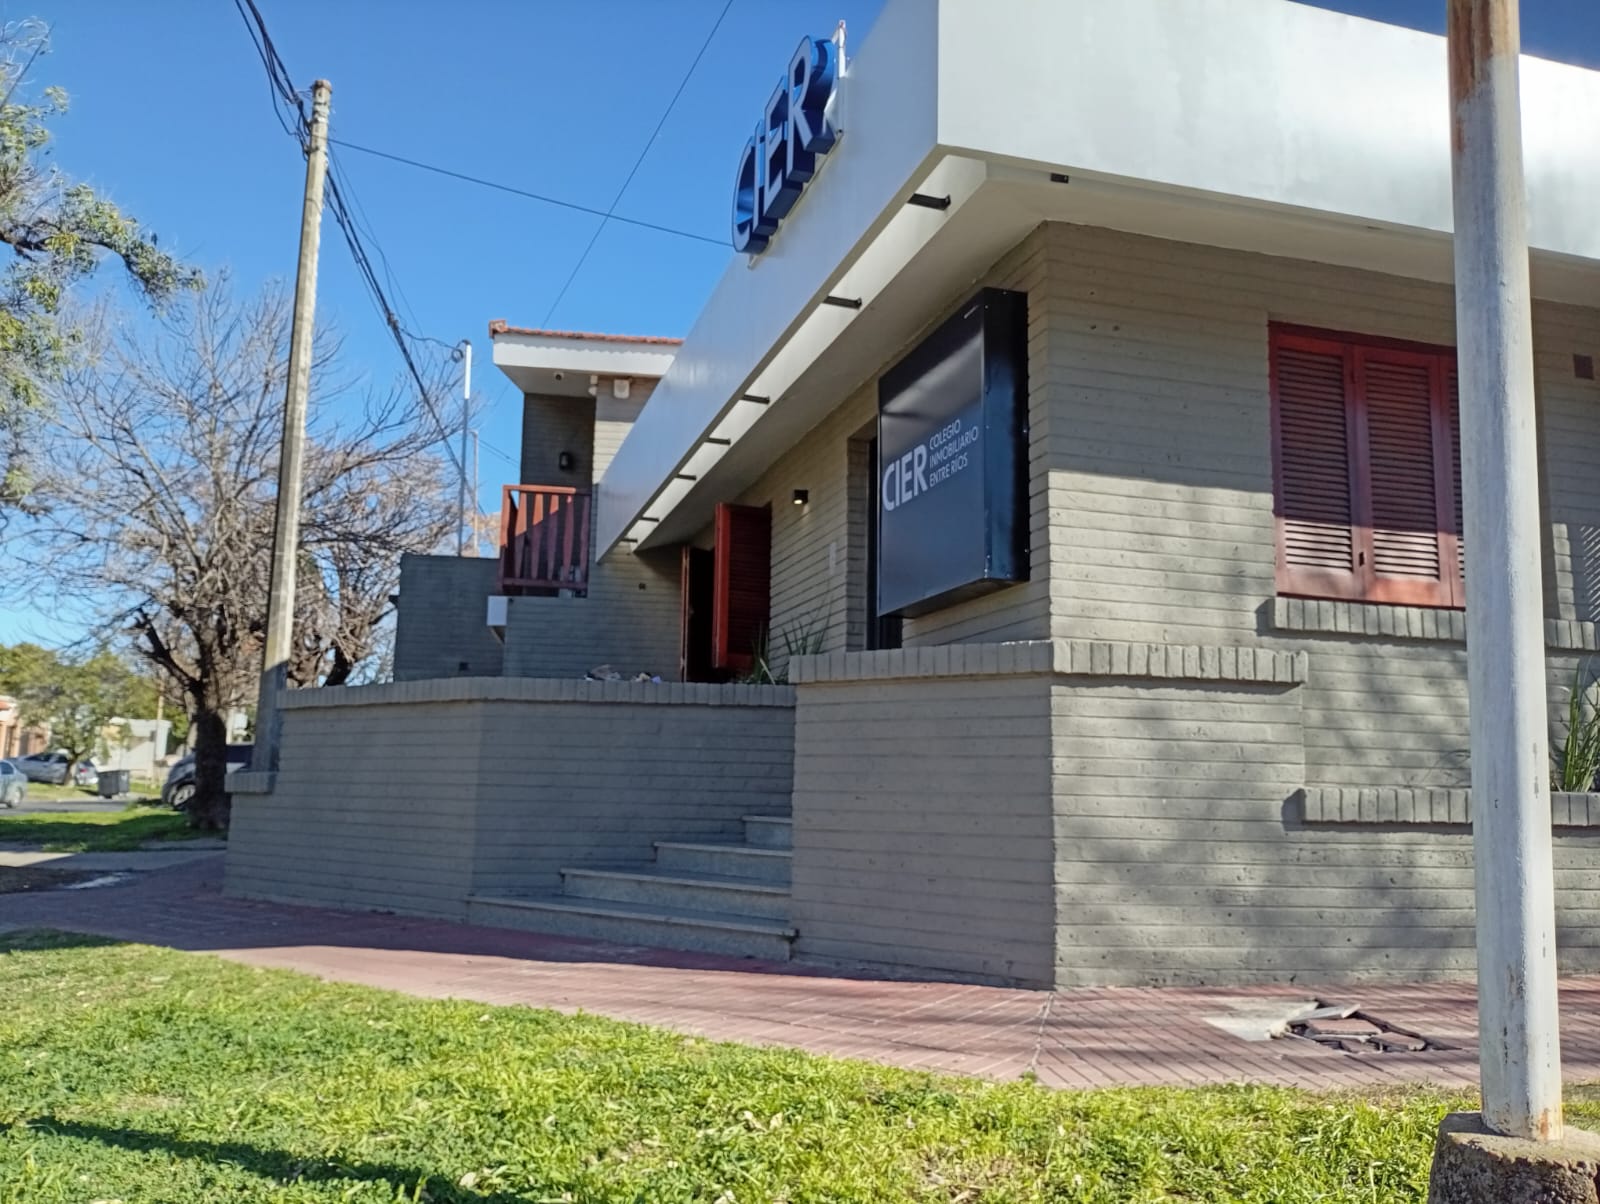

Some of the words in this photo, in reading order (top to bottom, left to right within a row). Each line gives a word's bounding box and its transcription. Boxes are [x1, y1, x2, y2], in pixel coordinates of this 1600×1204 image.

[732, 35, 836, 254] CIER
[929, 419, 961, 450] COLEGIO
[929, 426, 979, 468] INMOBILIARIO
[882, 444, 928, 511] CIER
[929, 464, 950, 487] ENTRE
